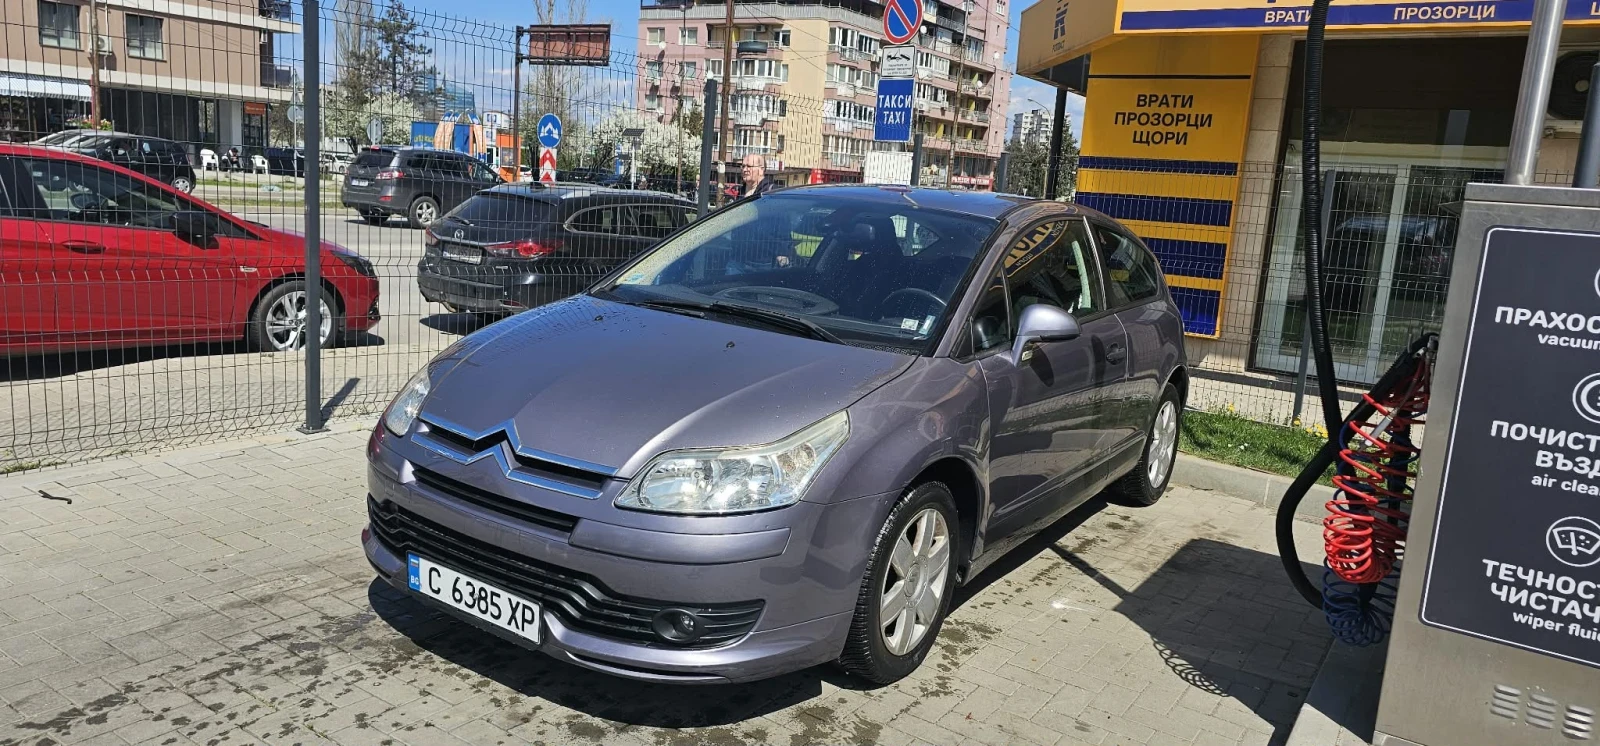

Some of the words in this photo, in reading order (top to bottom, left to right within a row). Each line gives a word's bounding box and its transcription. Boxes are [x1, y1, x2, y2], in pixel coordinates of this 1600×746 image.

[1393, 4, 1496, 21] ПРОЗОРЦИ
[879, 94, 912, 109] ТАКСИ
[1136, 93, 1194, 109] ВРАТИ
[883, 111, 905, 125] TAXI
[1114, 111, 1213, 130] ПРОЗОРЦИ
[1132, 130, 1188, 147] ЩОРИ
[1531, 473, 1558, 488] air
[1560, 479, 1600, 497] clea
[1482, 558, 1600, 600] ТЕЧНОС
[451, 576, 502, 621] 6385
[1490, 582, 1600, 625] ЧИСТАЧ
[1512, 612, 1565, 632] wiper
